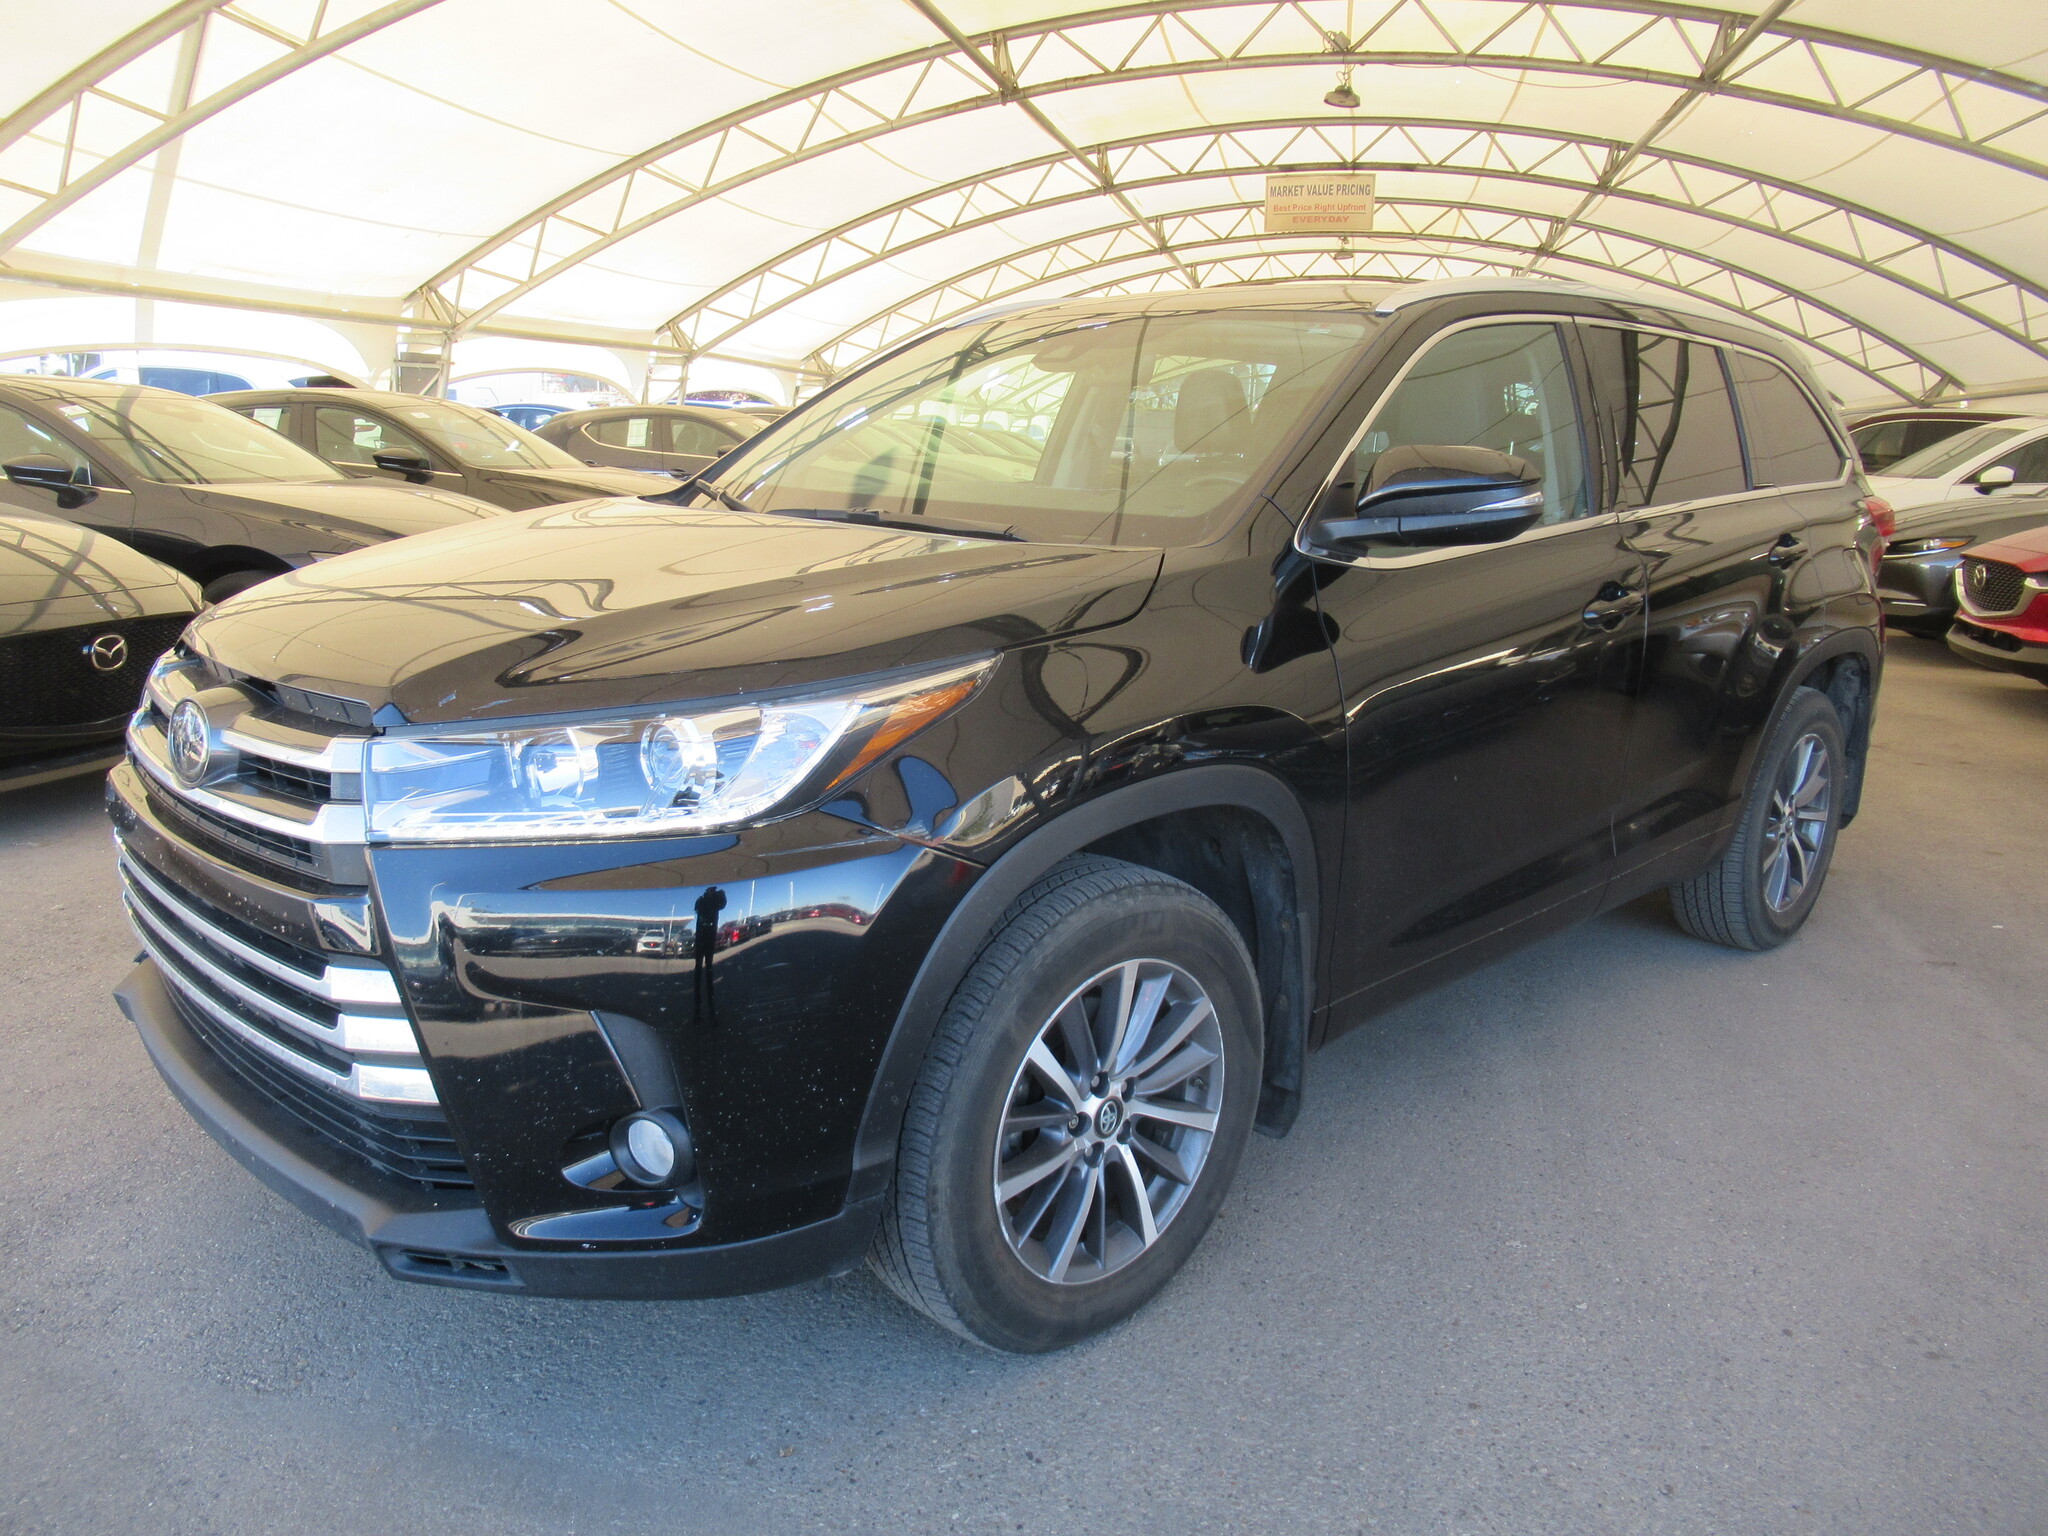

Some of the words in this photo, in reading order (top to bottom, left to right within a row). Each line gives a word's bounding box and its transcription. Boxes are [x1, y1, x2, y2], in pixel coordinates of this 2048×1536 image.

[1270, 185, 1304, 197] MARKET
[1307, 184, 1333, 196] VALUE
[1336, 184, 1371, 196] PRICING
[1273, 204, 1291, 212] Best
[1314, 203, 1335, 212] Right
[1337, 203, 1366, 212] Upfront
